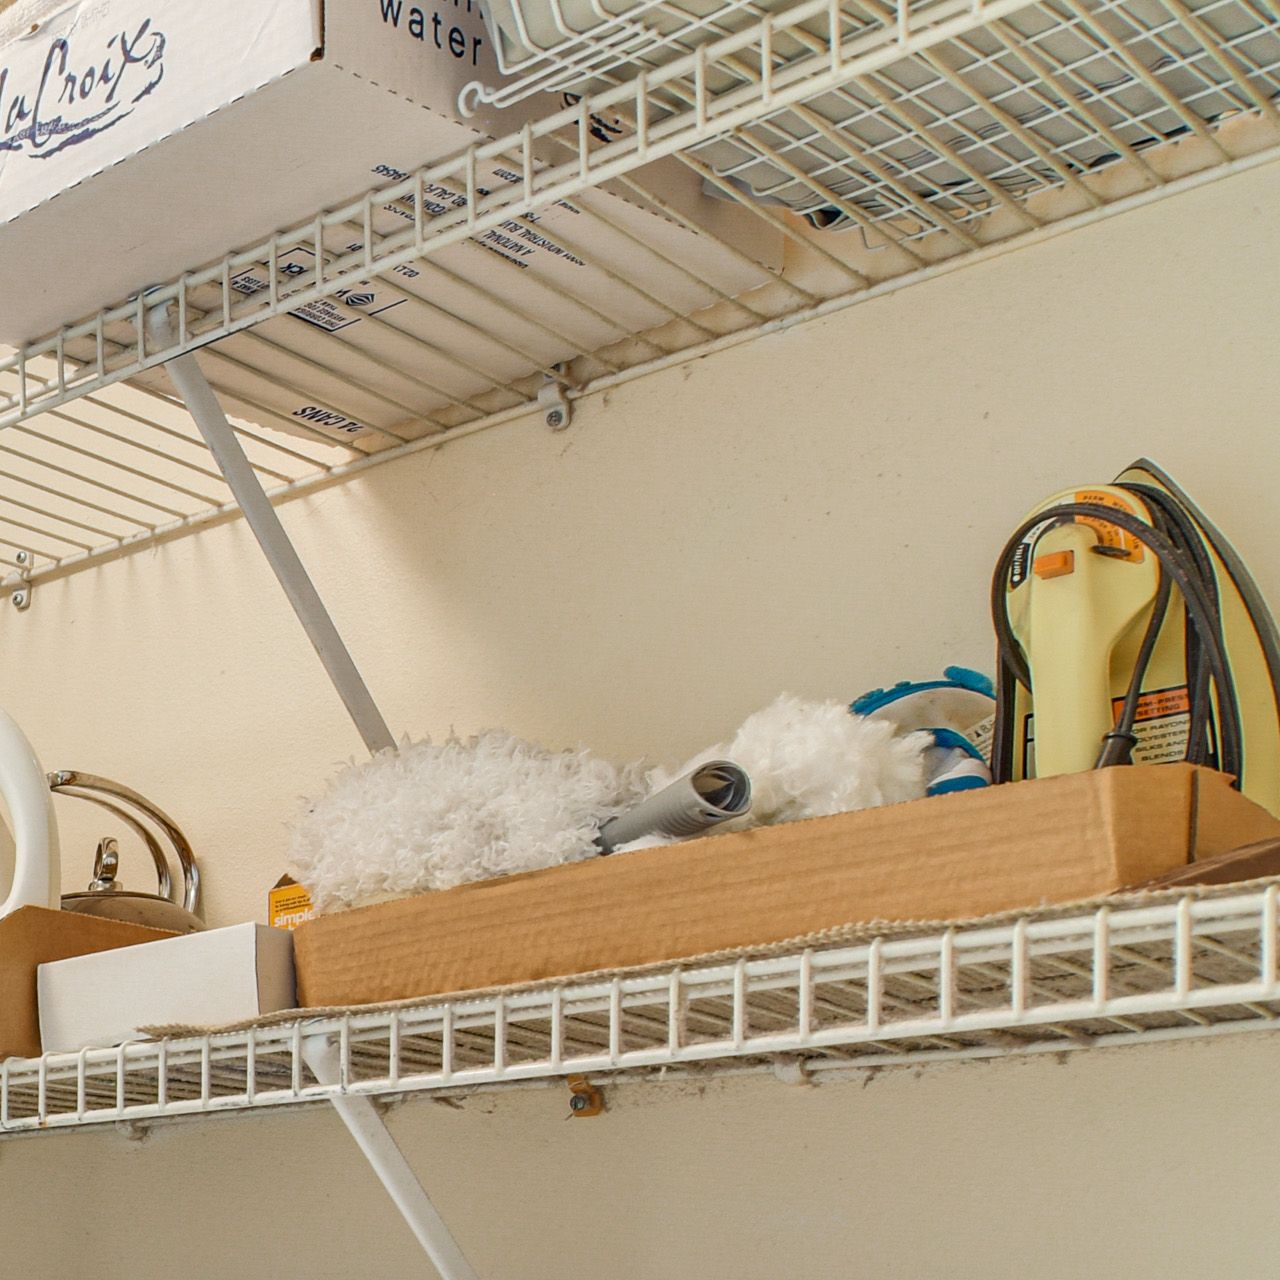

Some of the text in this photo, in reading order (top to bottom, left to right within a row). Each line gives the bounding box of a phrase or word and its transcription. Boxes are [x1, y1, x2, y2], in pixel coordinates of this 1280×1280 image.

[379, 0, 482, 65] water
[371, 164, 403, 182] 94545
[482, 229, 524, 252] NATIONAL
[291, 406, 347, 426] CANS
[1135, 743, 1163, 753] SILKS
[1141, 749, 1184, 761] BLENDS
